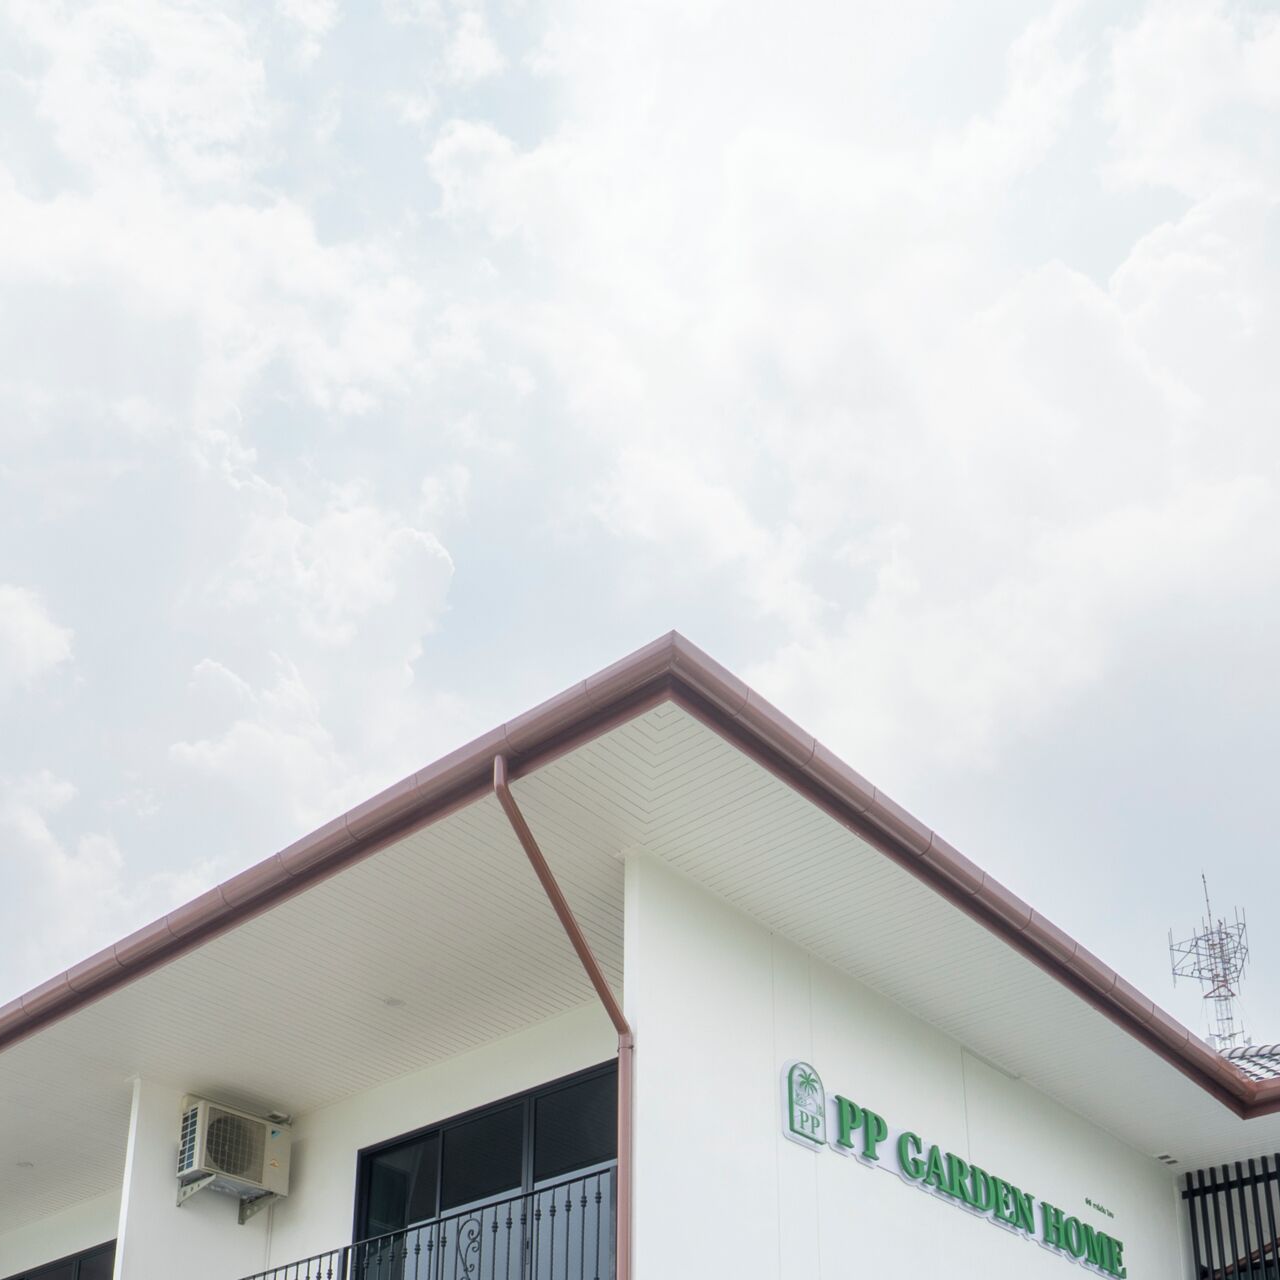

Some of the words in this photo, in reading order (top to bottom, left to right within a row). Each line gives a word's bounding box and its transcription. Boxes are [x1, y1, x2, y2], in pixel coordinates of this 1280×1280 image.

[799, 1109, 821, 1135] PP
[834, 1094, 888, 1161] PP
[897, 1131, 1036, 1235] GARDEN
[1040, 1201, 1127, 1279] HOME
